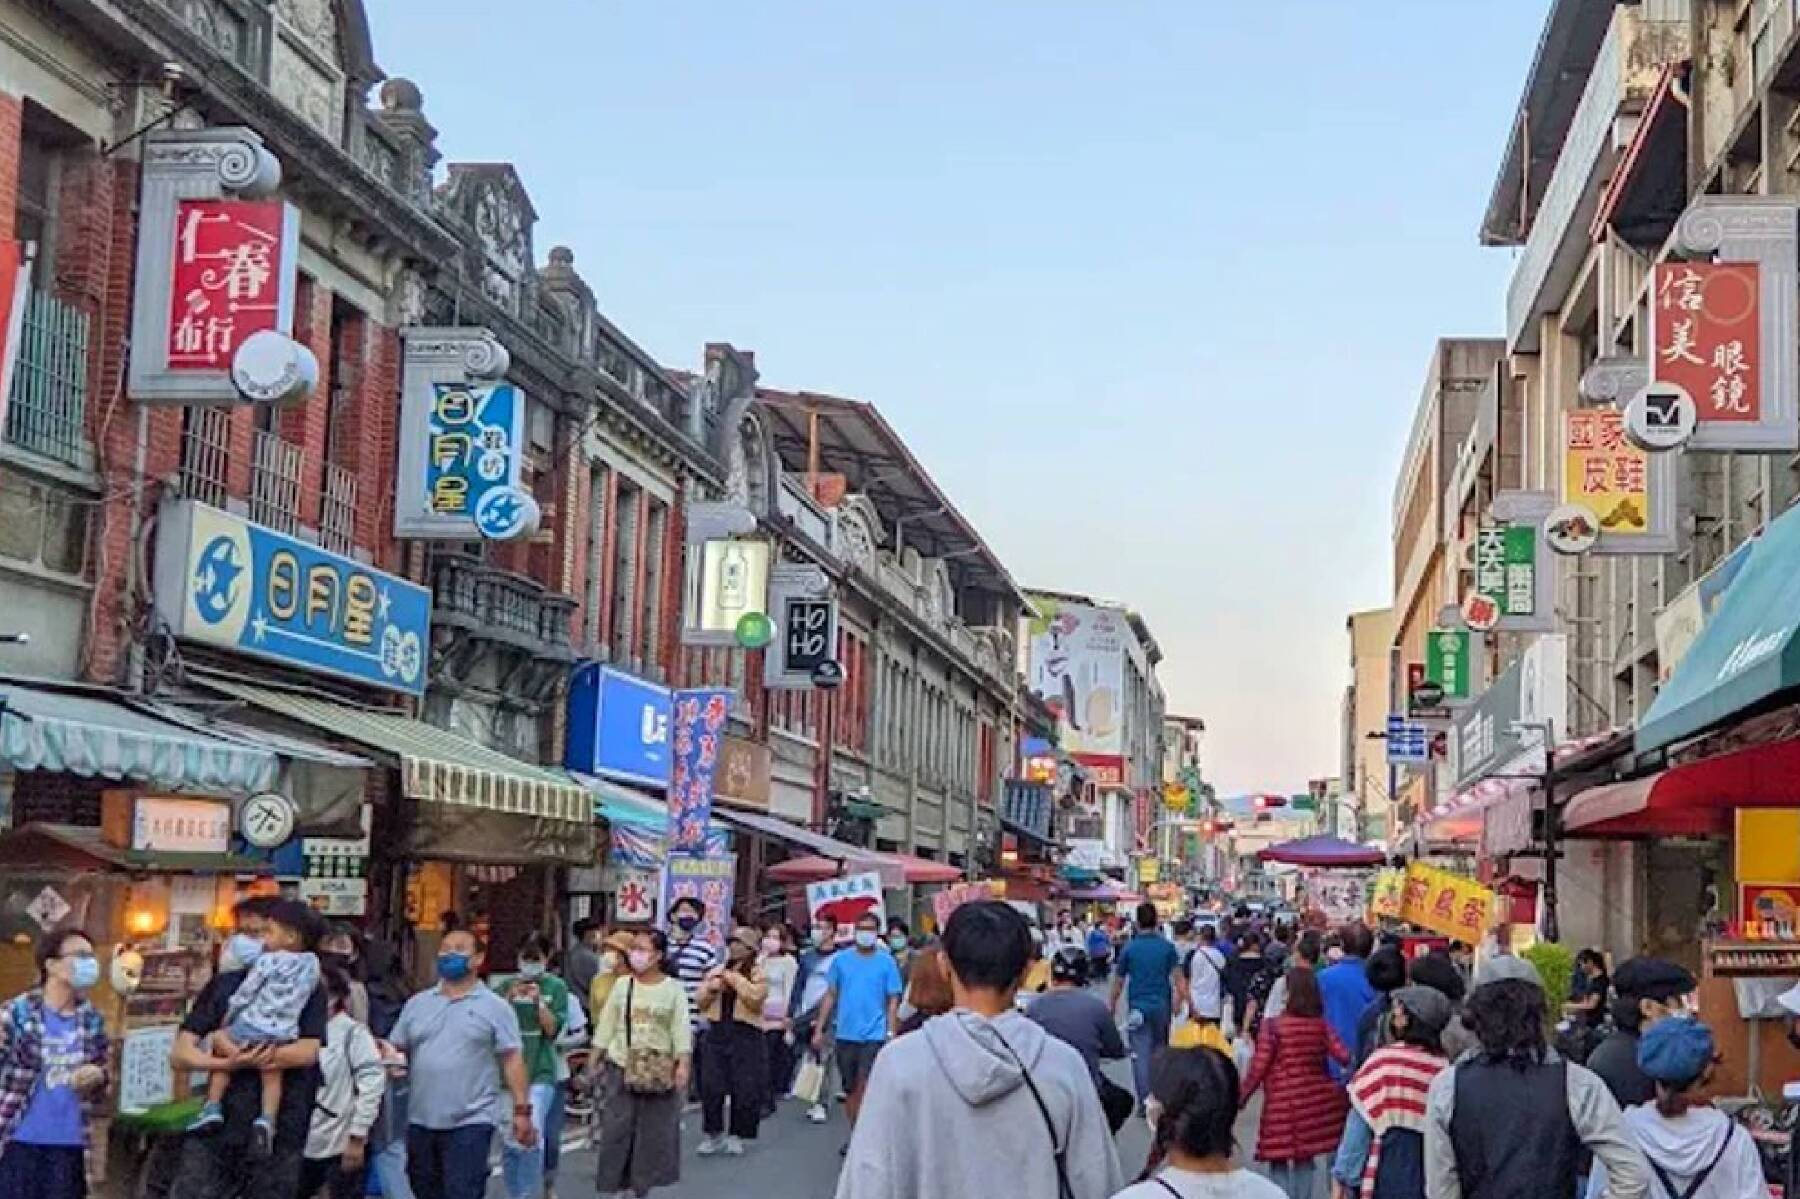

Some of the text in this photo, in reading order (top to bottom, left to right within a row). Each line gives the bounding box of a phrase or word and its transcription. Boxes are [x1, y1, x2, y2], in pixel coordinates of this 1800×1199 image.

[176, 315, 236, 353] 布行
[1660, 268, 1706, 364] 信美
[1711, 341, 1750, 412] 眼鏡
[434, 391, 474, 512] 日月星
[1568, 413, 1627, 450] 國家
[1583, 456, 1645, 493] 皮鞋
[269, 551, 376, 644] 日月星
